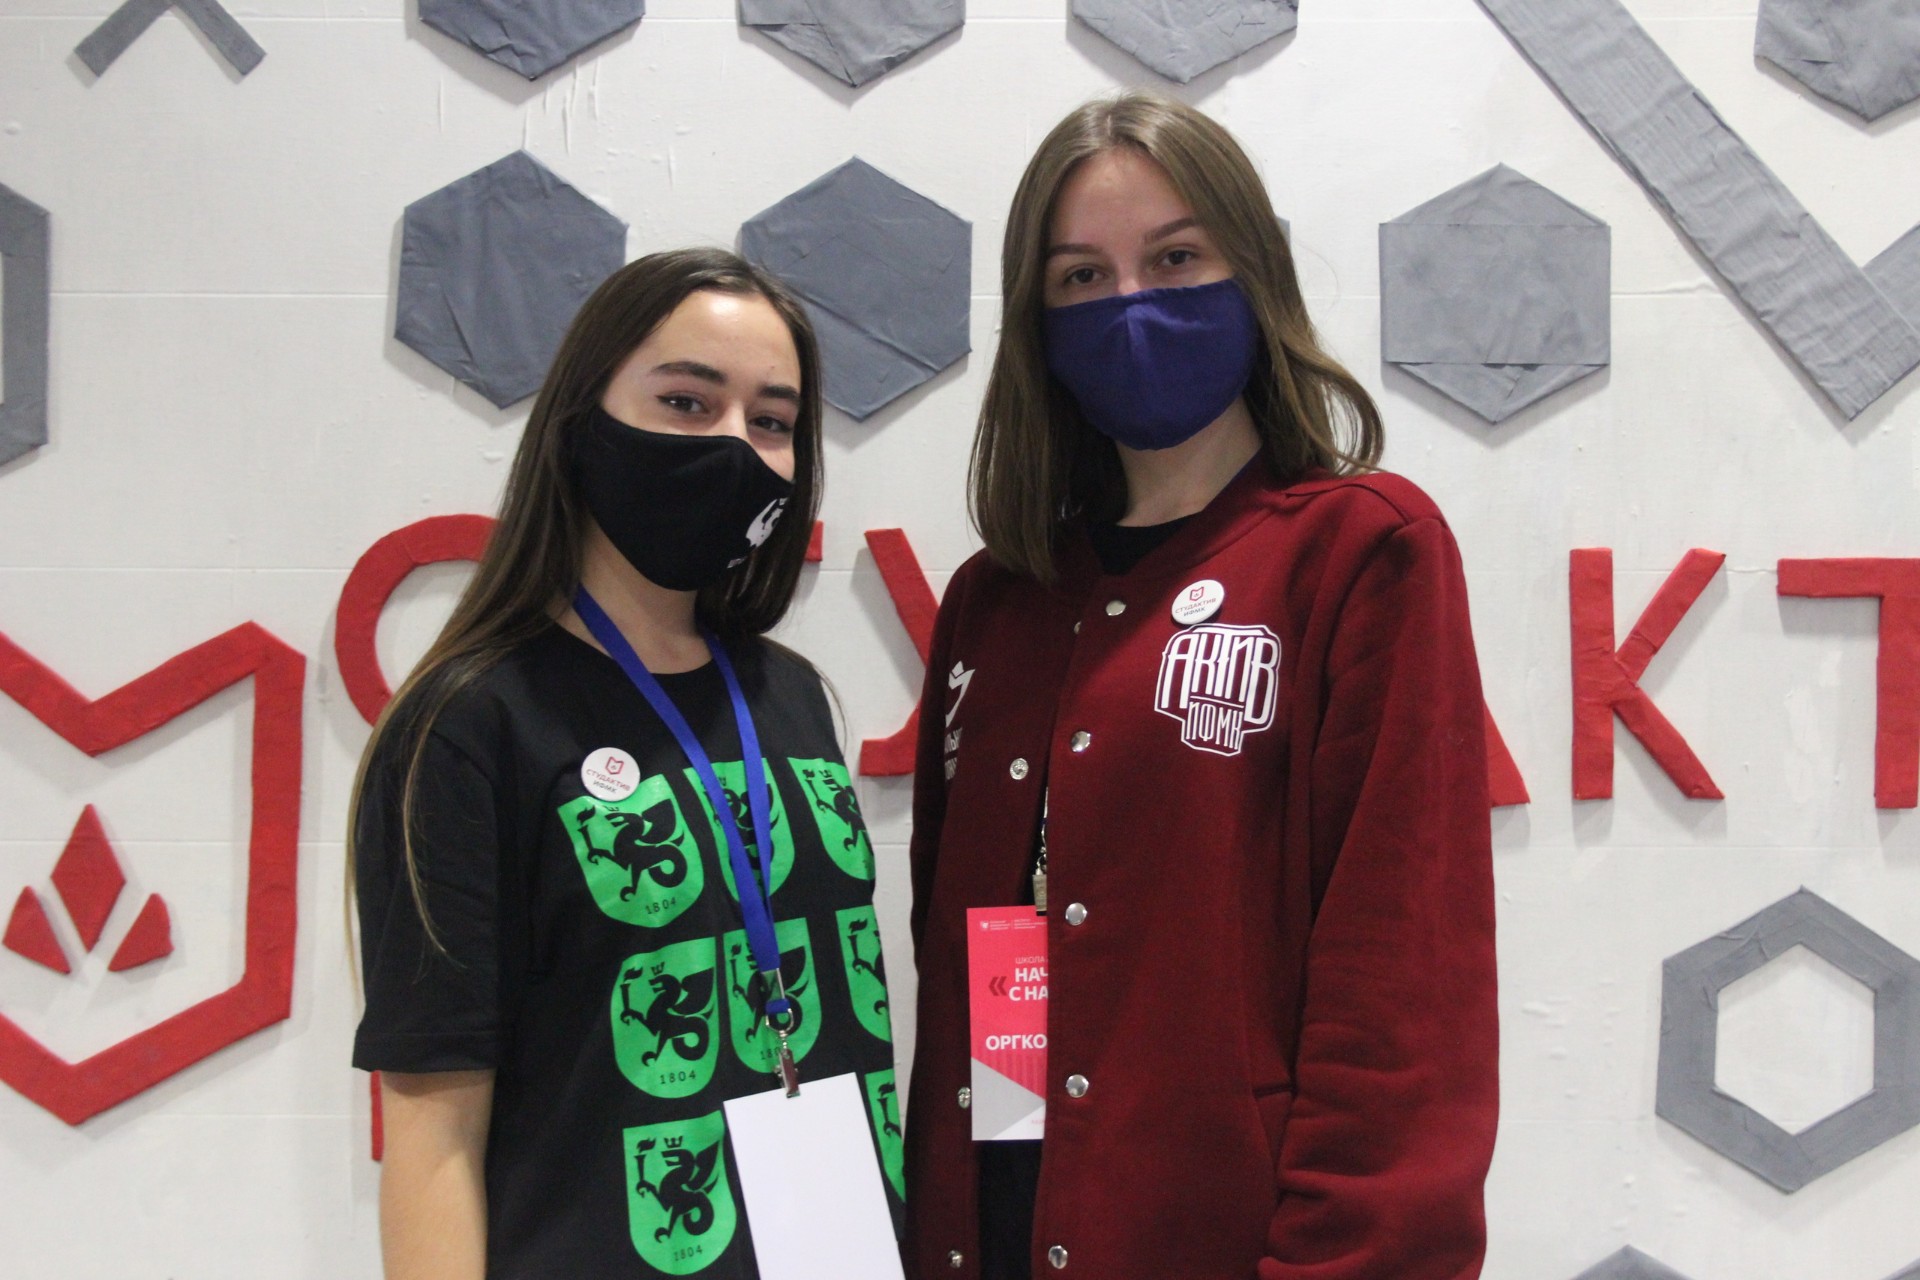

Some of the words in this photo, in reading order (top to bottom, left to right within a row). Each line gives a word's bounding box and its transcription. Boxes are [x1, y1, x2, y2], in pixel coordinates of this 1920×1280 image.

[1175, 598, 1216, 614] СТУДАКТИВ
[1161, 627, 1278, 725] АКТИВ
[1186, 701, 1244, 750] ИФМК
[586, 768, 631, 792] СТУДАКТИВ
[593, 780, 617, 794] ИФМК
[645, 896, 676, 915] 1804
[1015, 956, 1045, 965] ШКОЛА
[1008, 986, 1021, 1001] С
[985, 1034, 1048, 1051] ОРГКО
[660, 1070, 696, 1085] 1804
[674, 1245, 703, 1262] 1804
